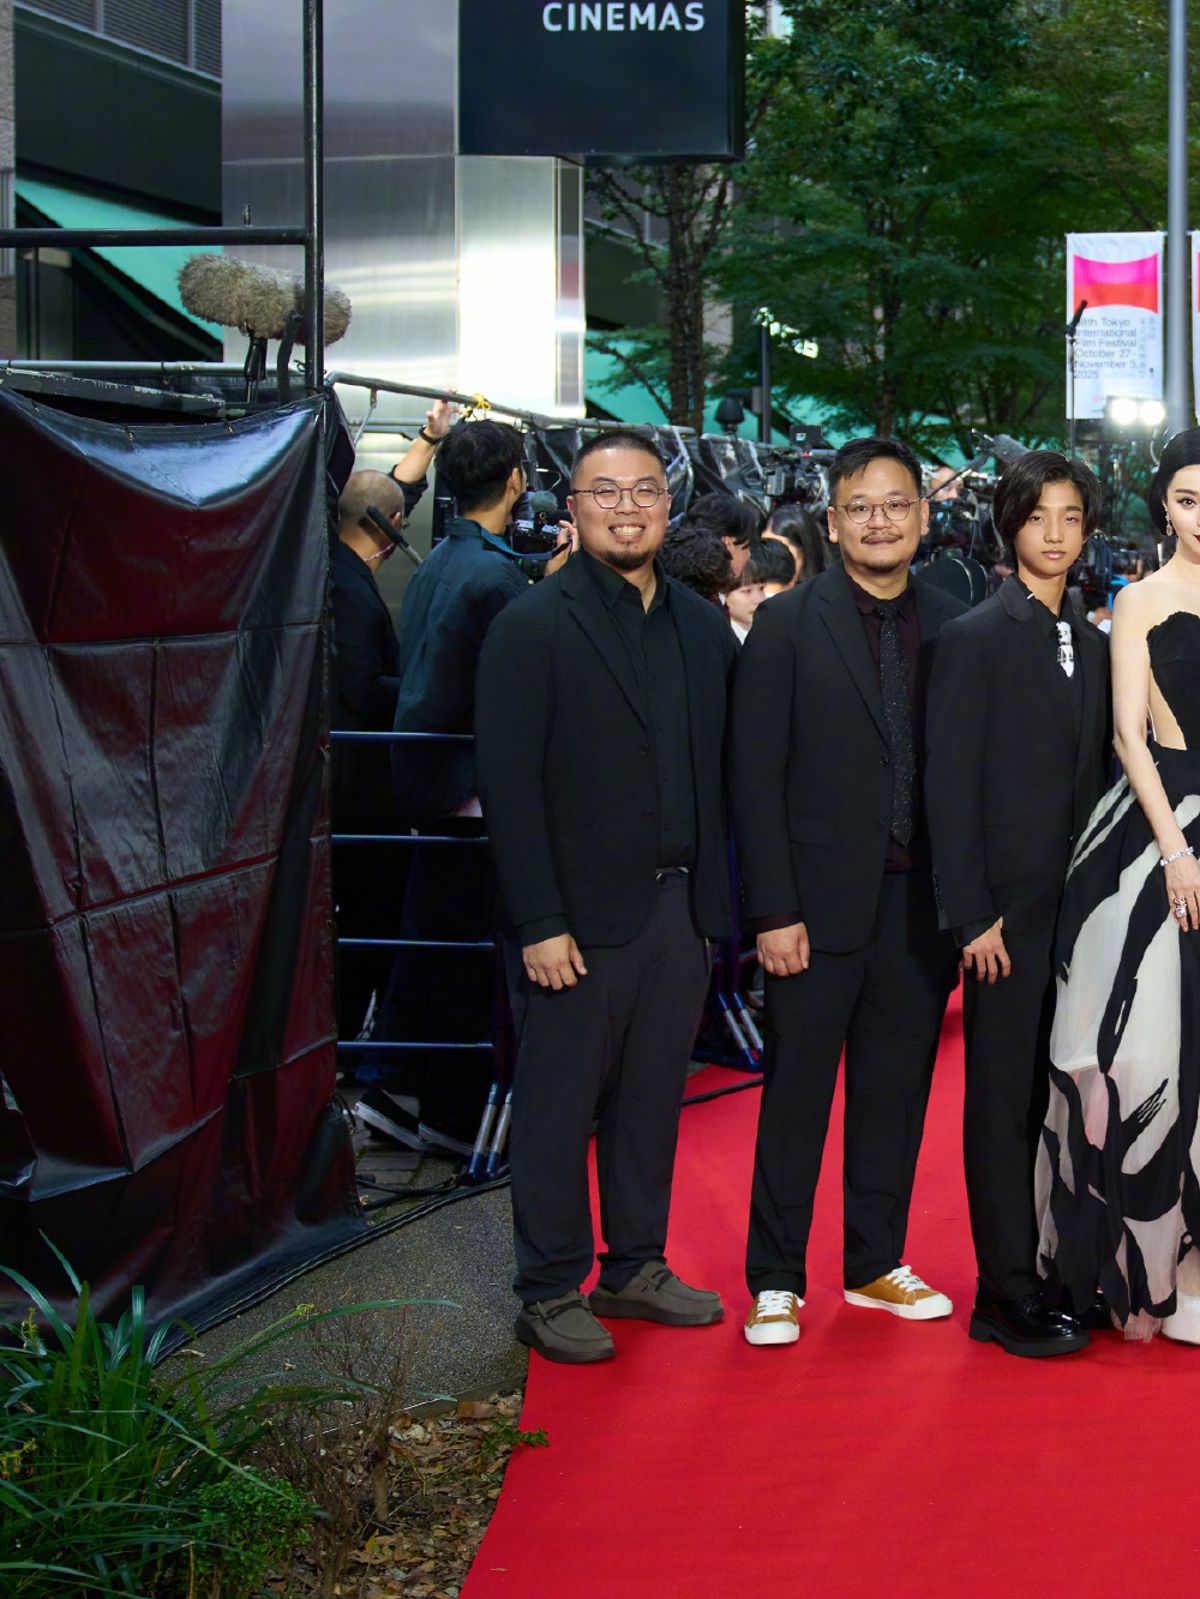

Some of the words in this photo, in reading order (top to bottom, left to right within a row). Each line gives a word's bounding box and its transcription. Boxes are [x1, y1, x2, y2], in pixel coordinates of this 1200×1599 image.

[542, 2, 705, 31] CINEMAS
[1076, 317, 1097, 327] 8th
[1102, 317, 1130, 327] Tokyo
[1075, 328, 1136, 337] International
[1099, 338, 1136, 347] Festival
[1074, 349, 1115, 358] October
[1074, 359, 1127, 369] November
